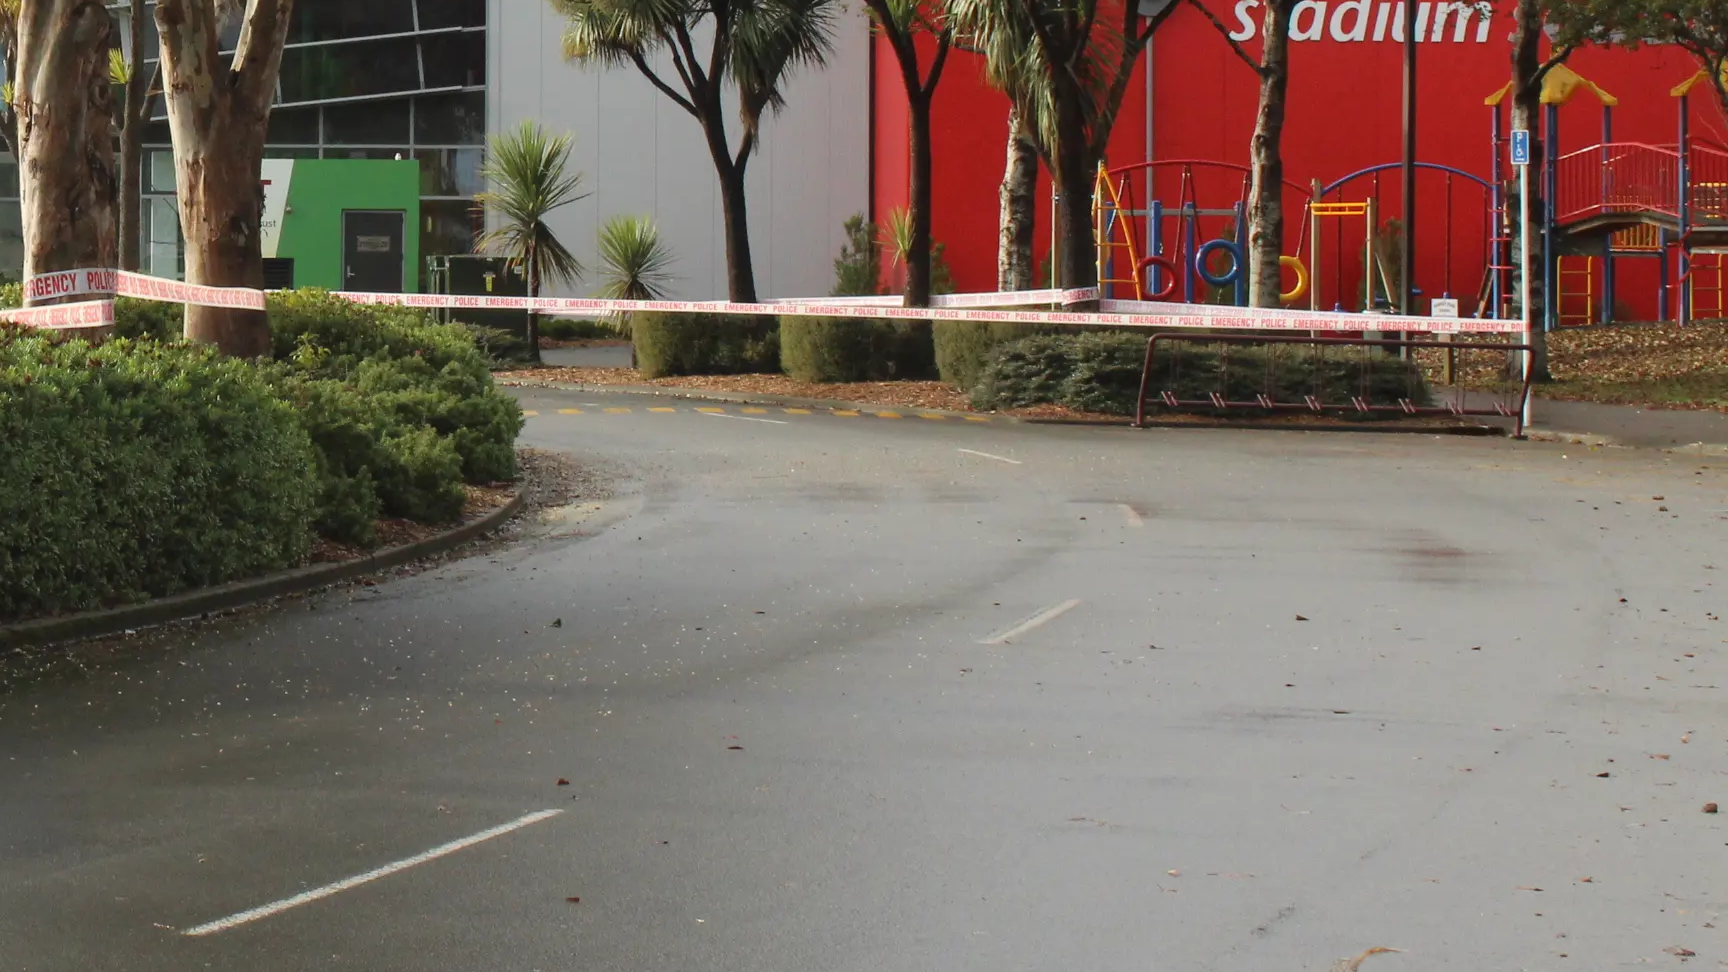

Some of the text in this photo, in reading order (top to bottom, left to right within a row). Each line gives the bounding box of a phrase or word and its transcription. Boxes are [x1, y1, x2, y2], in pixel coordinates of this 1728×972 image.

[407, 296, 449, 306] EMERGENCY
[454, 297, 479, 306] POLICE
[485, 298, 528, 307] EMERGENCY
[533, 299, 558, 308] POLICE
[565, 300, 608, 309] EMERGENCY
[613, 301, 638, 309] POLICE
[644, 301, 688, 310] EMERGENCY
[693, 302, 718, 311] POLICE
[724, 304, 767, 313] EMERGENCY
[773, 305, 798, 314] POLICE
[804, 306, 848, 315] EMERGENCY
[853, 307, 878, 316] POLICE
[885, 308, 929, 318] EMERGENCY
[934, 309, 959, 318] POLICE
[966, 311, 1010, 320] EMERGENCY
[1015, 312, 1040, 321] POLICE
[1047, 313, 1091, 322] EMERGENCY
[1097, 314, 1122, 323] POLICE
[1128, 315, 1173, 325] EMERGENCY
[1178, 316, 1204, 326] POLICE
[1211, 318, 1256, 327] EMERGENCY
[1261, 318, 1287, 328] POLICE
[1293, 319, 1338, 329] EMERGENCY
[1343, 320, 1369, 330] POLICE
[1376, 321, 1422, 331] EMERGENCY
[1426, 322, 1453, 331] POLICE
